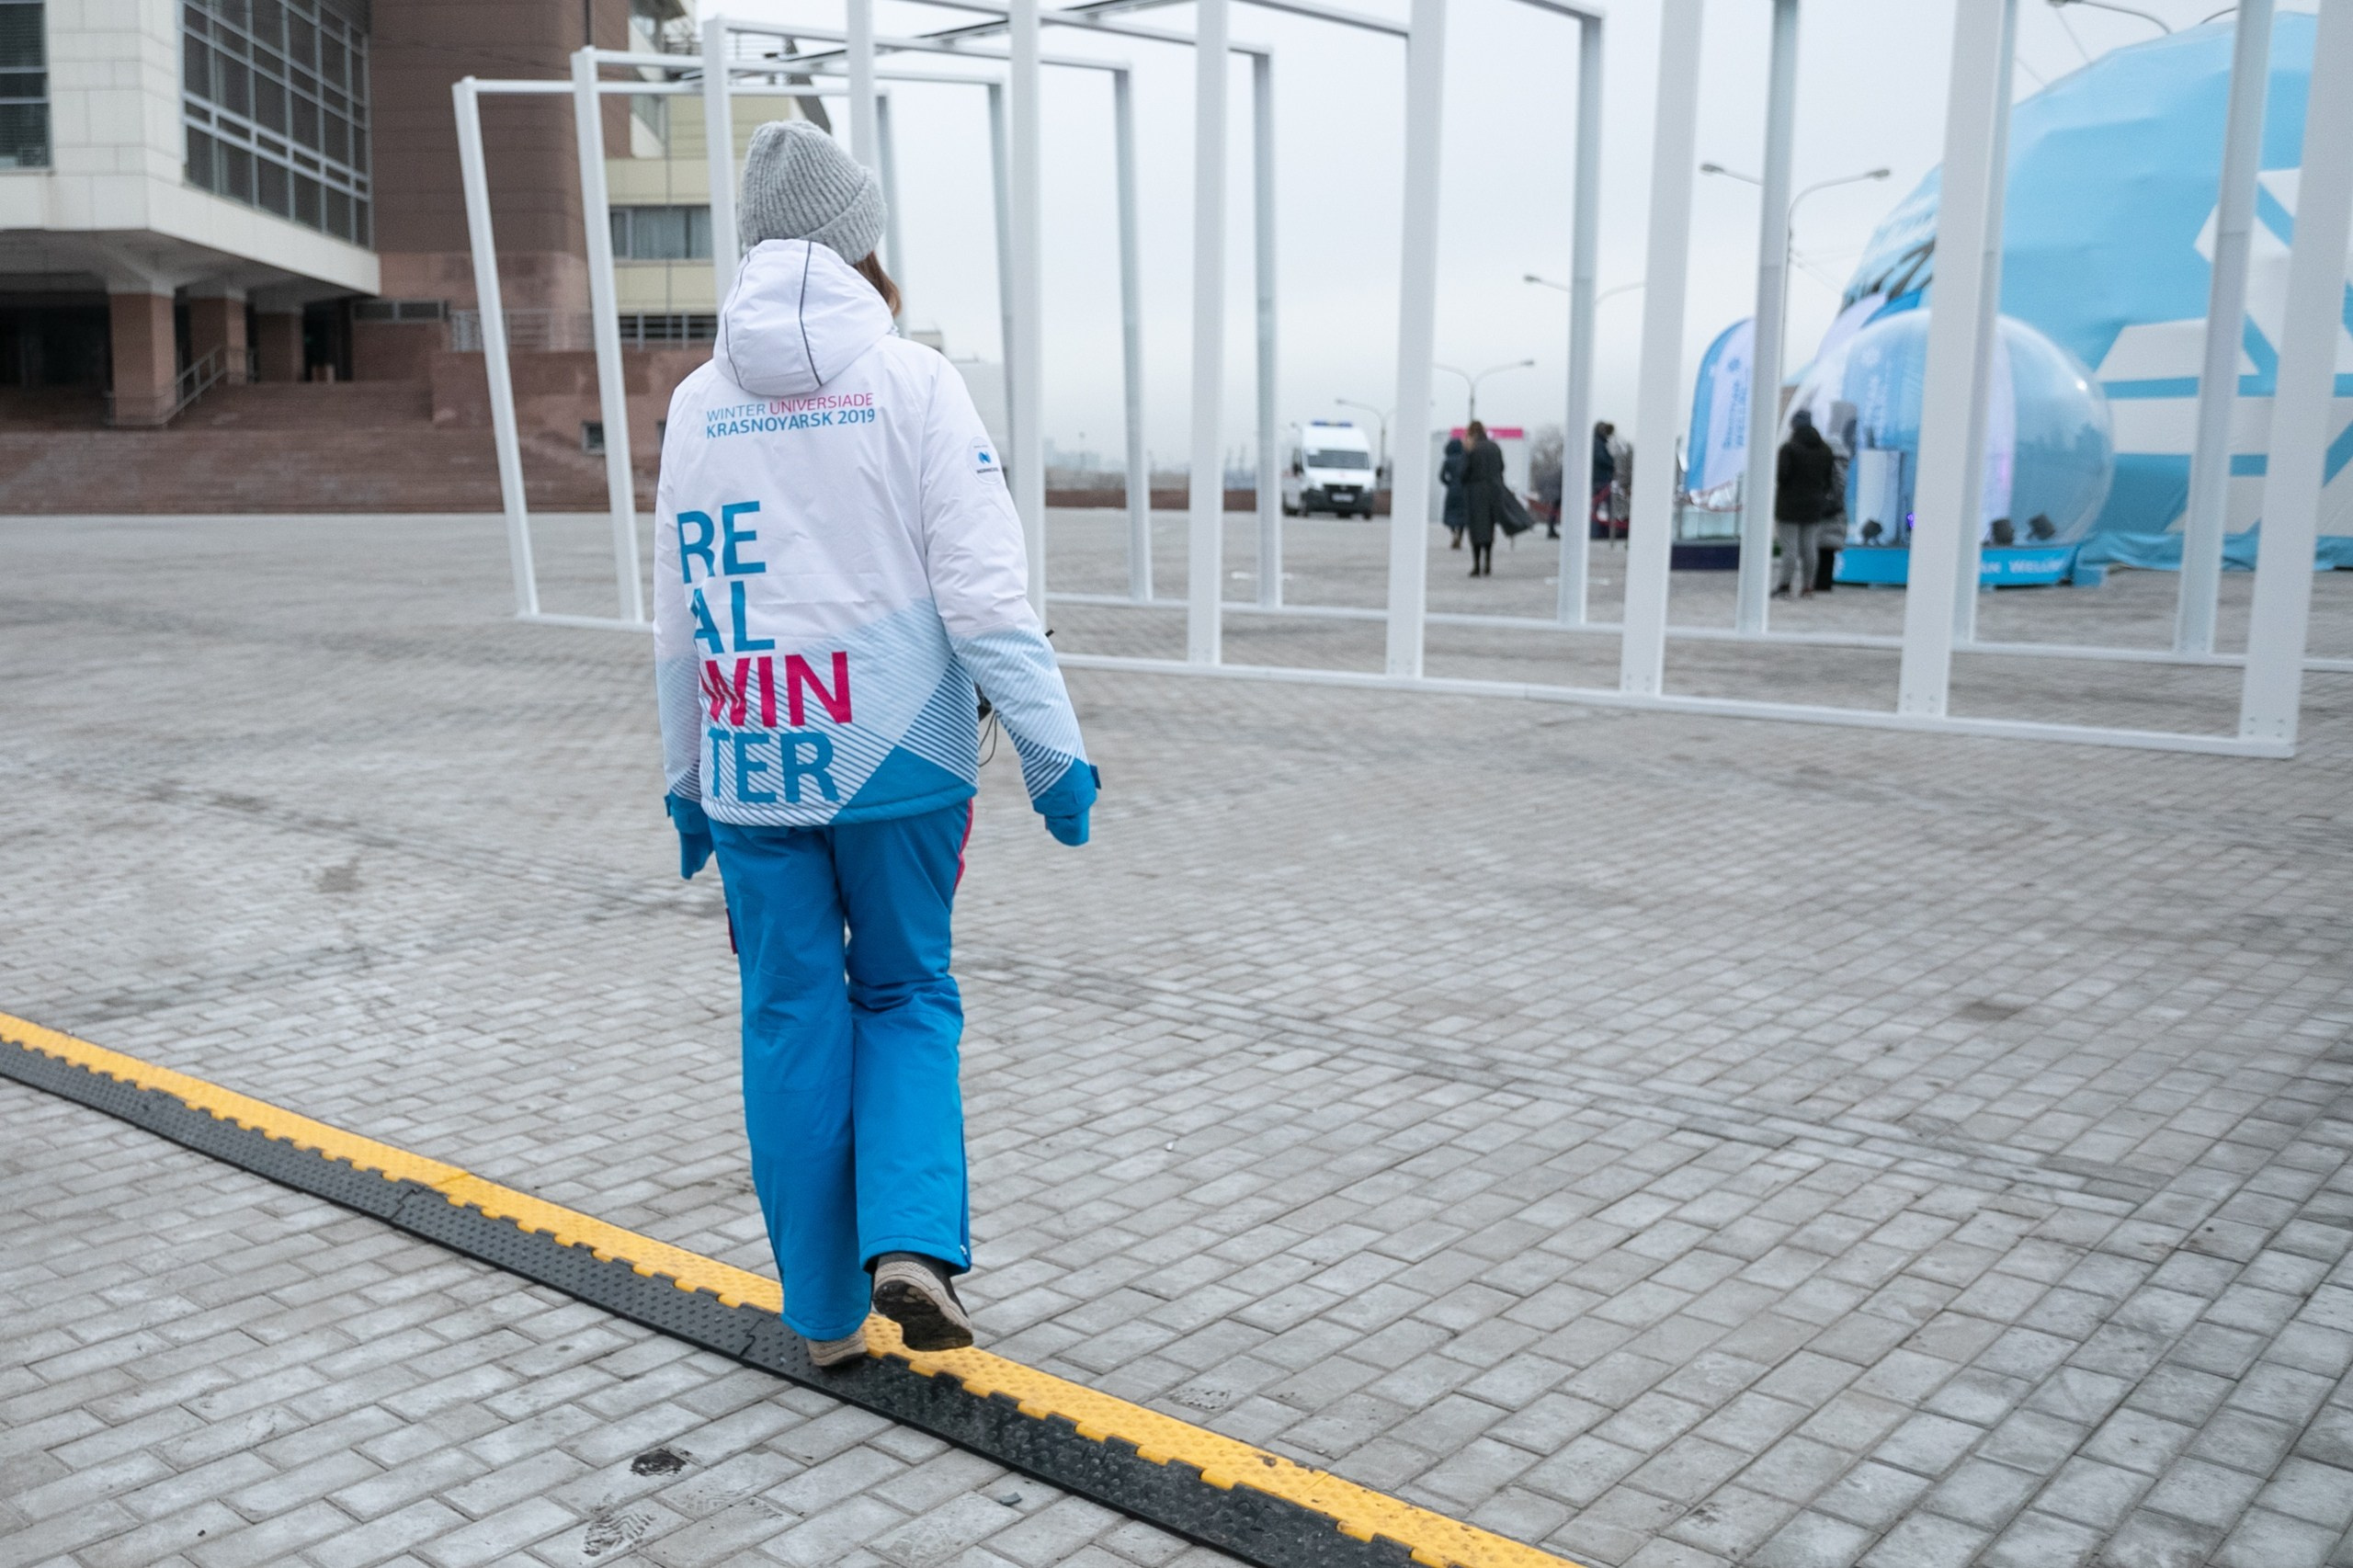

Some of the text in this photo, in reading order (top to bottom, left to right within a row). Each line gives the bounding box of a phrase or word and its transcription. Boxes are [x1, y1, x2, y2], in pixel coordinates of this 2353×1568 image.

[707, 392, 873, 422] WINTER UNIVERSIADE
[707, 408, 876, 438] KRASNOYARSK 2019
[676, 501, 766, 584] RE
[690, 581, 775, 653] AL
[699, 652, 852, 727] WIN
[708, 728, 840, 803] TER
